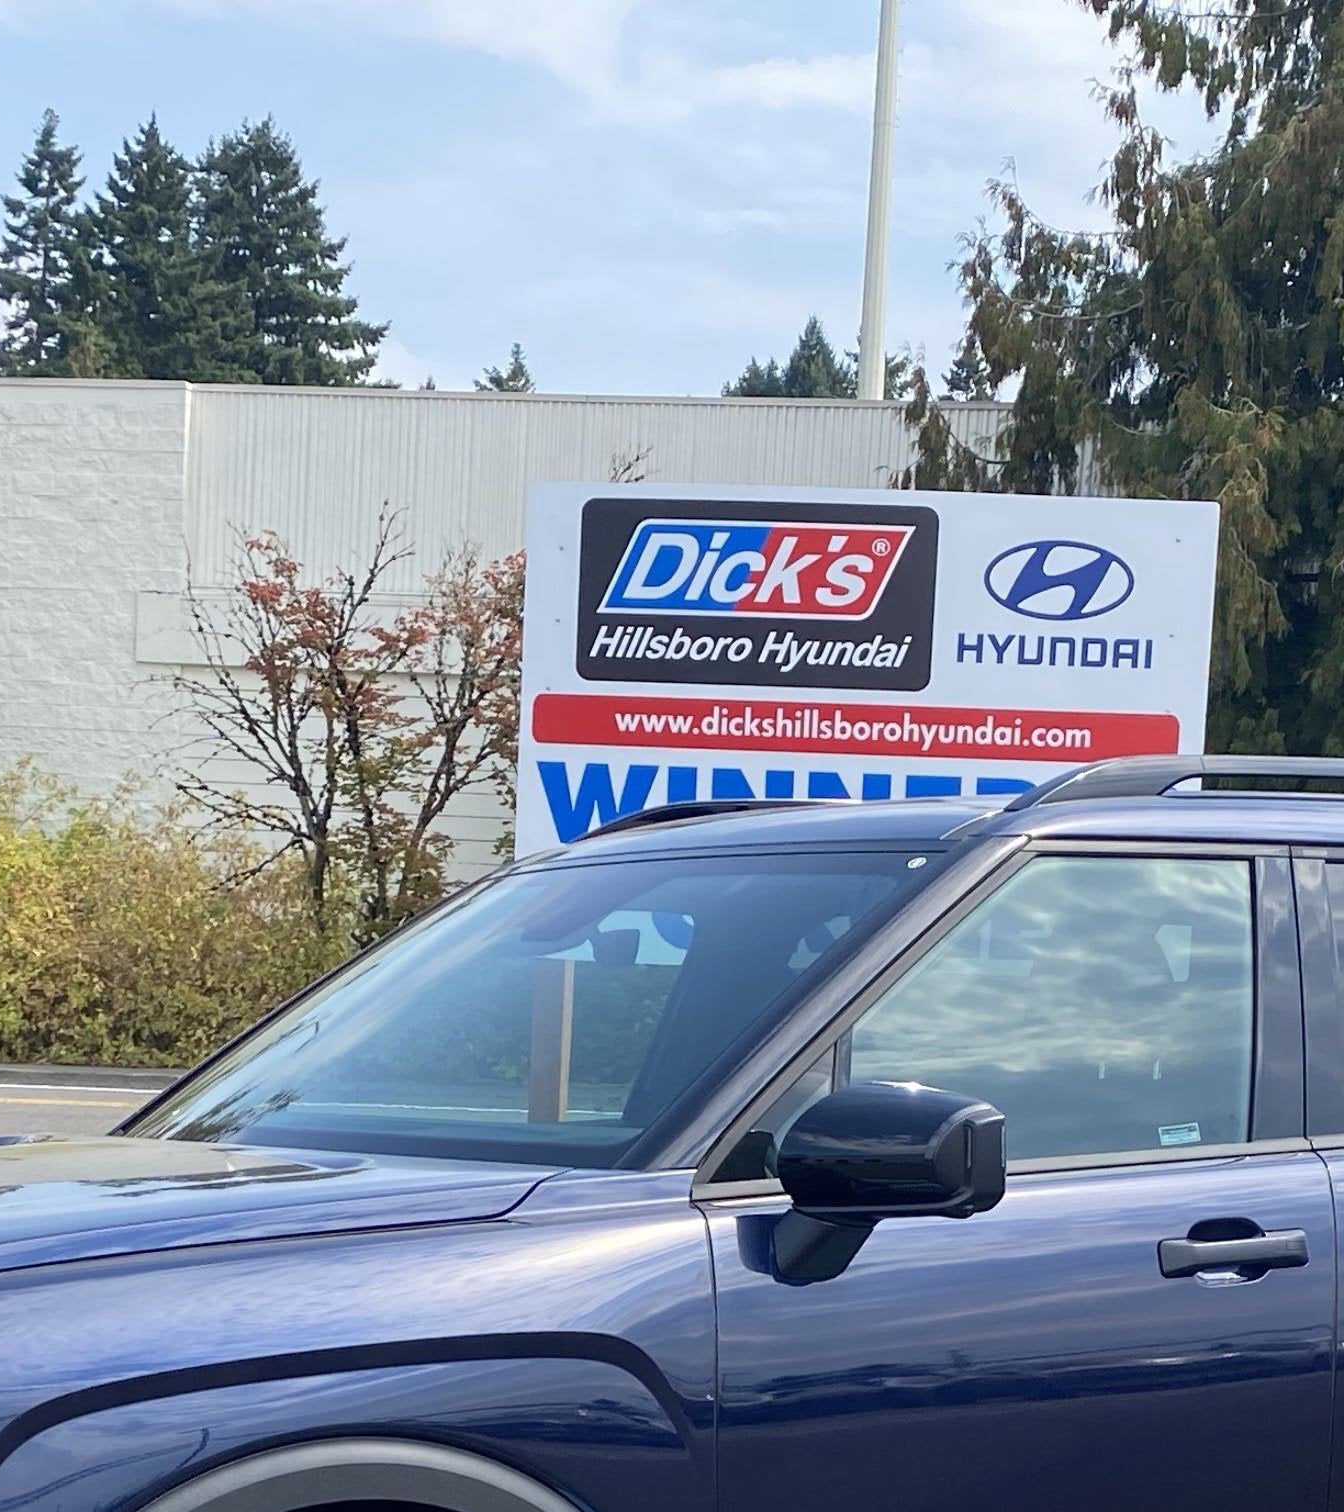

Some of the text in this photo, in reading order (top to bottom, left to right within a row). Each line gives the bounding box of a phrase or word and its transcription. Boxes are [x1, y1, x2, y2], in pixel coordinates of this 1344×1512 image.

[589, 625, 913, 673] Hillsboro Hyundai
[957, 632, 1153, 669] HYUNDAI
[615, 706, 1092, 752] www.dickshillsborohyundai.com
